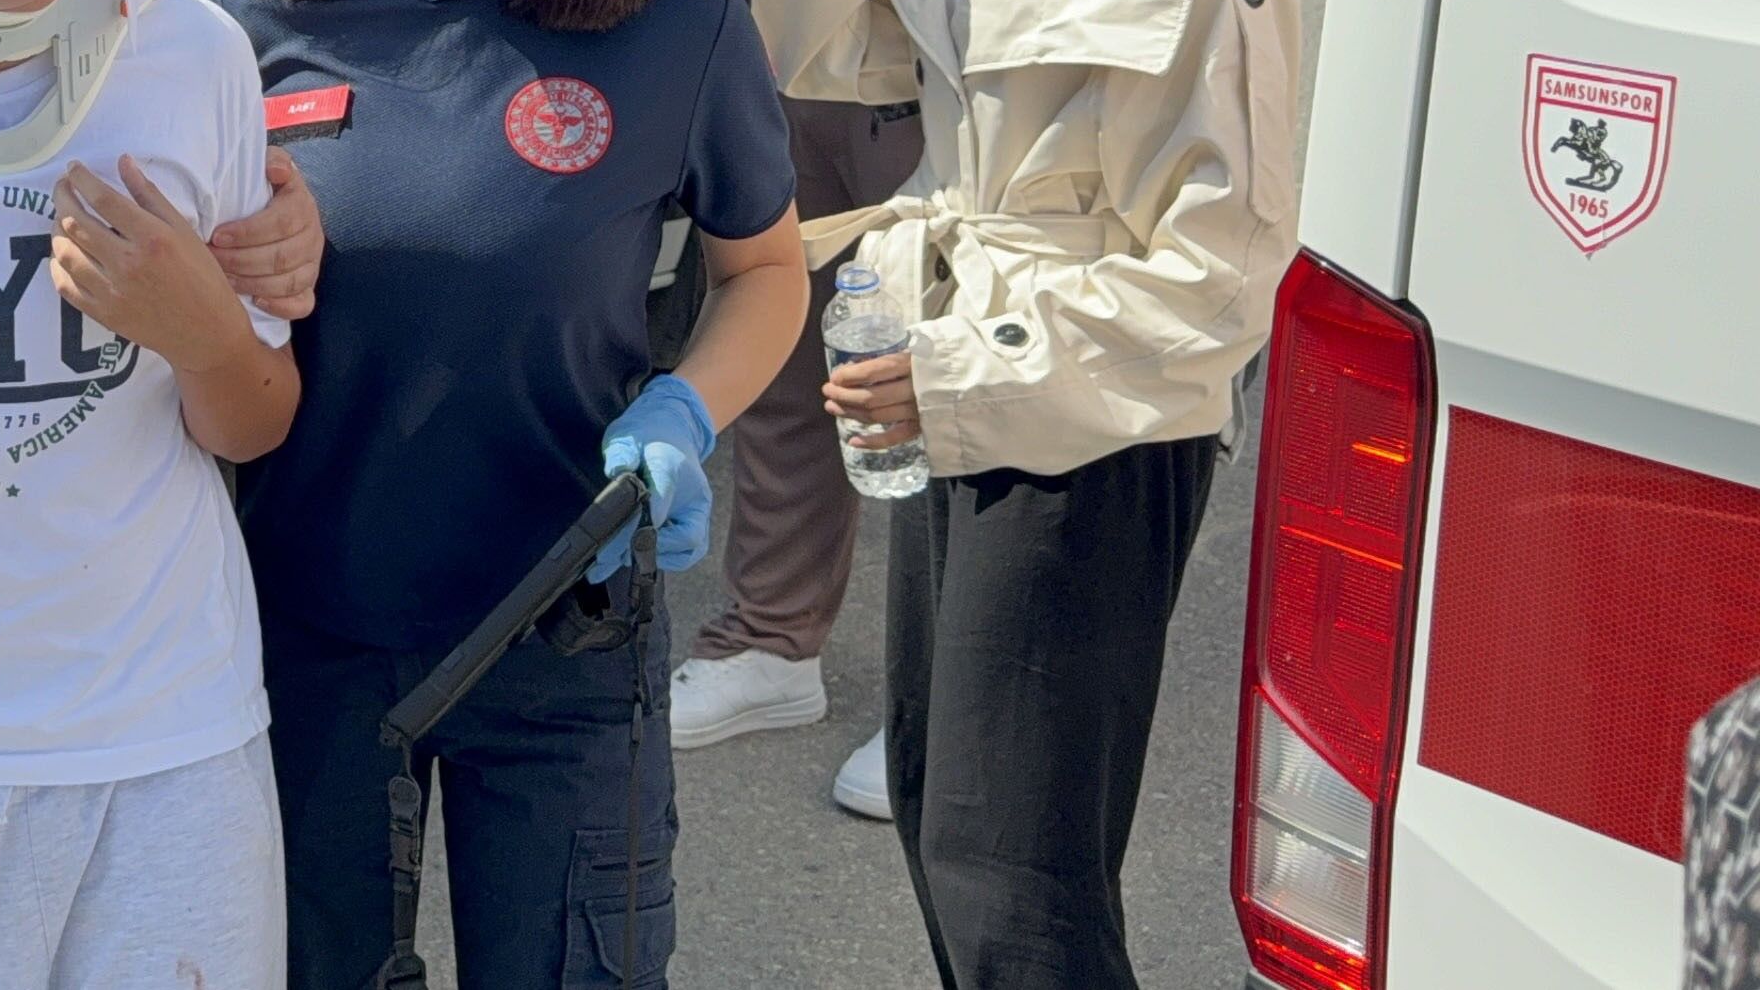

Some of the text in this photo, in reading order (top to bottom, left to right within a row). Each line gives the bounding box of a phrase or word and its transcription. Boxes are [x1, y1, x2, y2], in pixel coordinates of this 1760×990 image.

[1544, 79, 1654, 113] SAMSUNSPOR
[1568, 192, 1610, 219] 1965
[98, 341, 122, 374] OF
[6, 380, 105, 464] AMERICA
